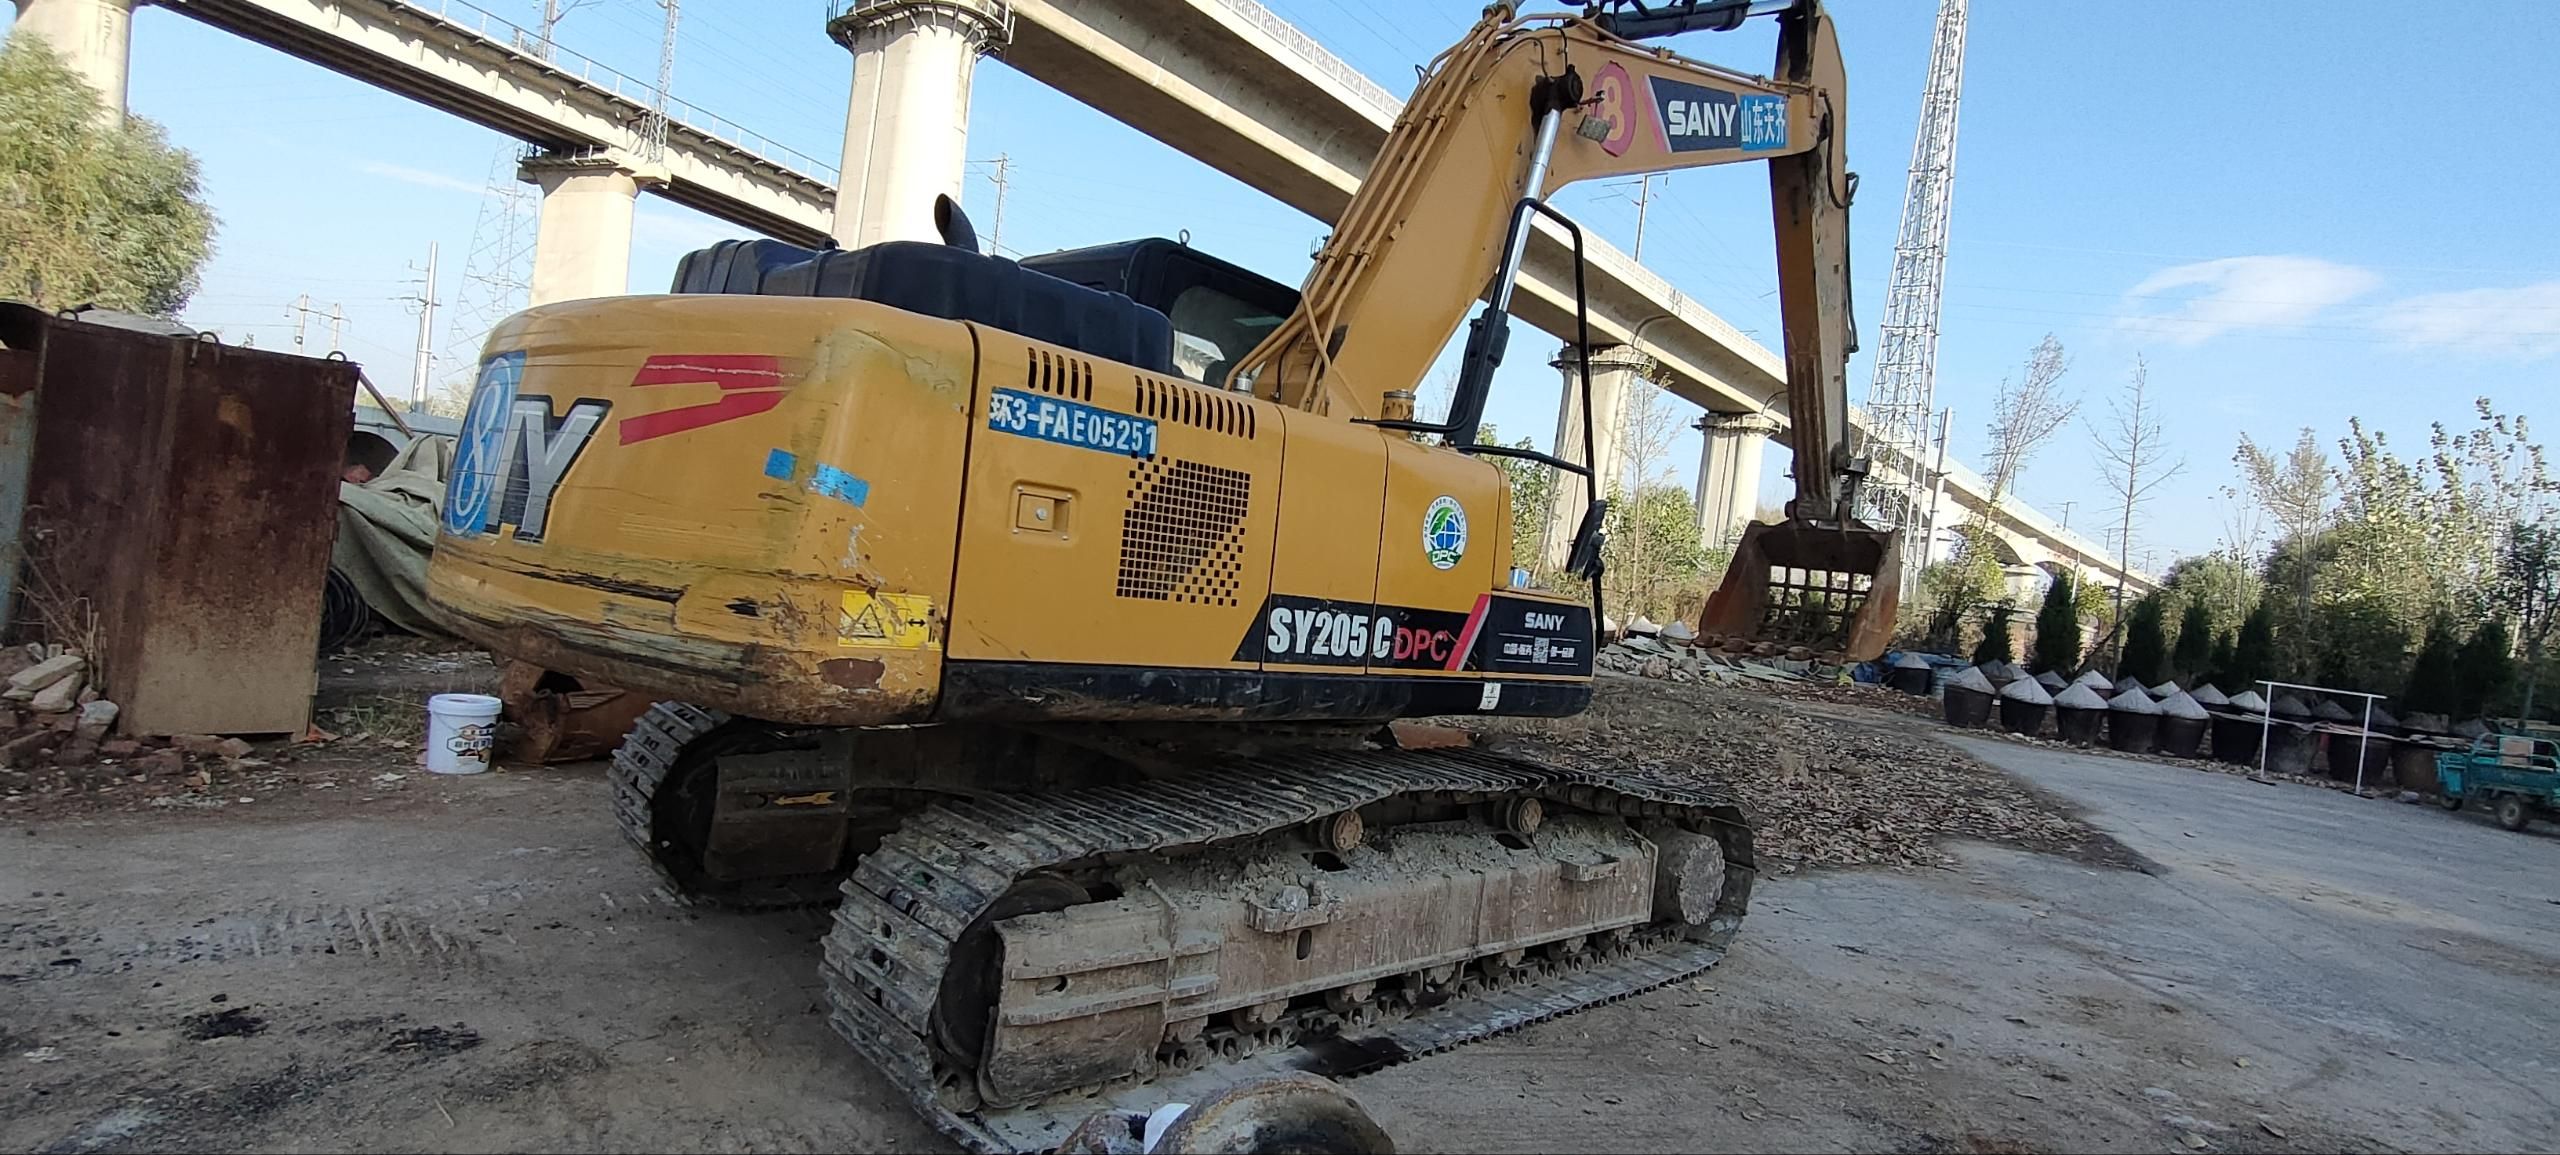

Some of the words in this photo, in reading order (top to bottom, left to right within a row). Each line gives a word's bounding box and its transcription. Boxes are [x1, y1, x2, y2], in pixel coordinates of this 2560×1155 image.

[1668, 100, 1737, 137] SANY
[1741, 99, 1786, 145] 山东天齐
[989, 393, 1158, 456] 环3-FAE05251
[1432, 550, 1457, 563] DPC
[1524, 611, 1565, 632] SANY
